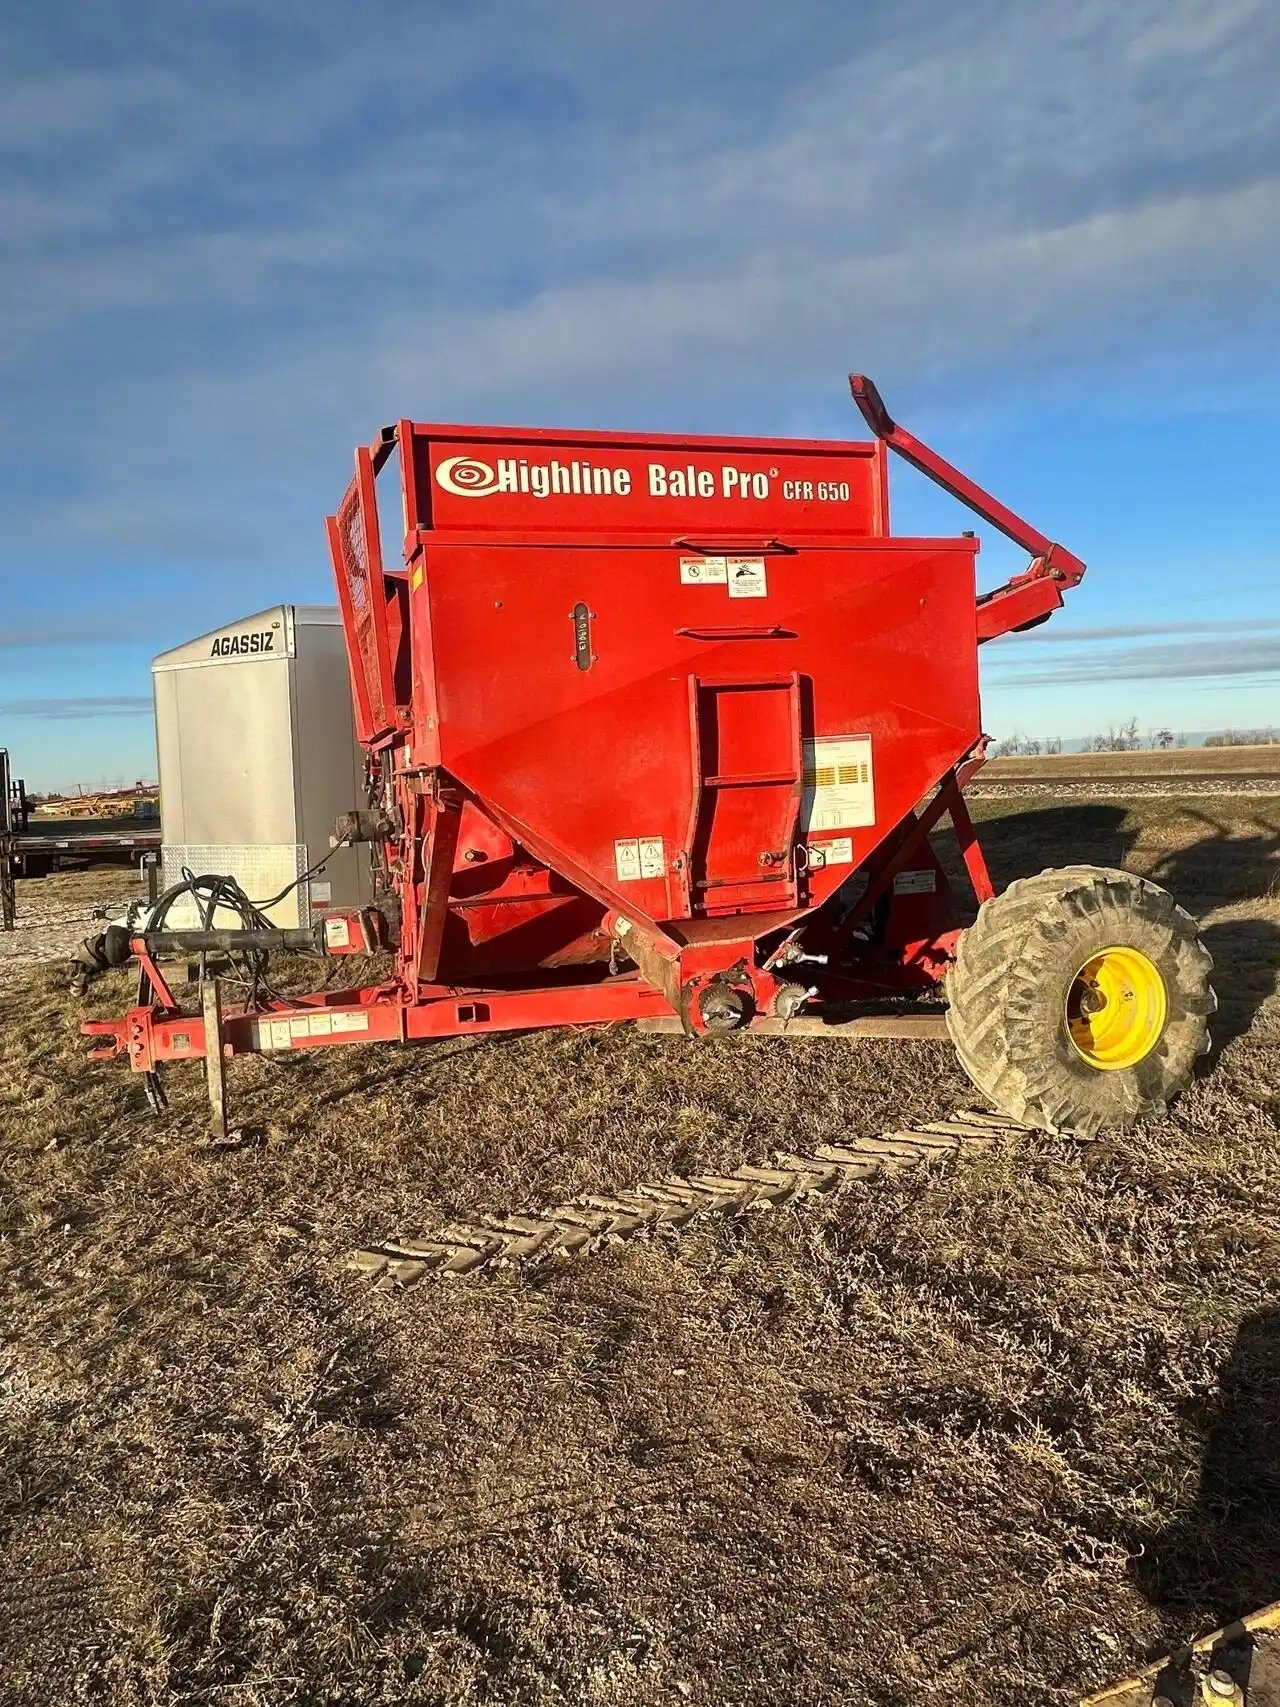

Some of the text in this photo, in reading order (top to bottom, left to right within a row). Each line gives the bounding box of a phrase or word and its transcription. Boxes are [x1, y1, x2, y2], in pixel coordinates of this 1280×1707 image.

[497, 458, 631, 498] Highline
[648, 463, 715, 498] Bale
[783, 480, 814, 500] CFR
[817, 481, 850, 501] 650
[211, 631, 274, 656] AGASSIZ
